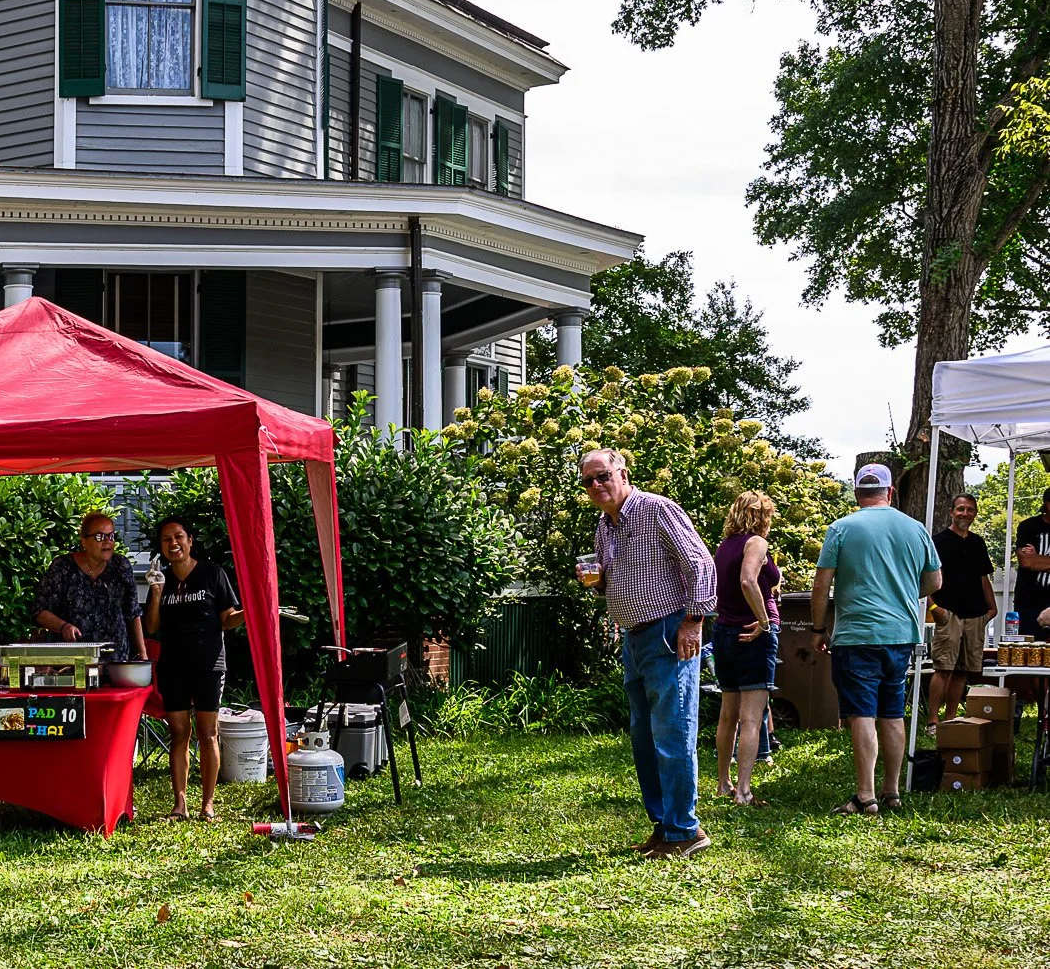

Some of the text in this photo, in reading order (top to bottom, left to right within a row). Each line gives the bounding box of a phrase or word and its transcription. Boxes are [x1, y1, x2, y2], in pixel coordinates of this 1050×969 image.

[28, 707, 77, 722] PAD 10
[26, 724, 64, 736] THAI
